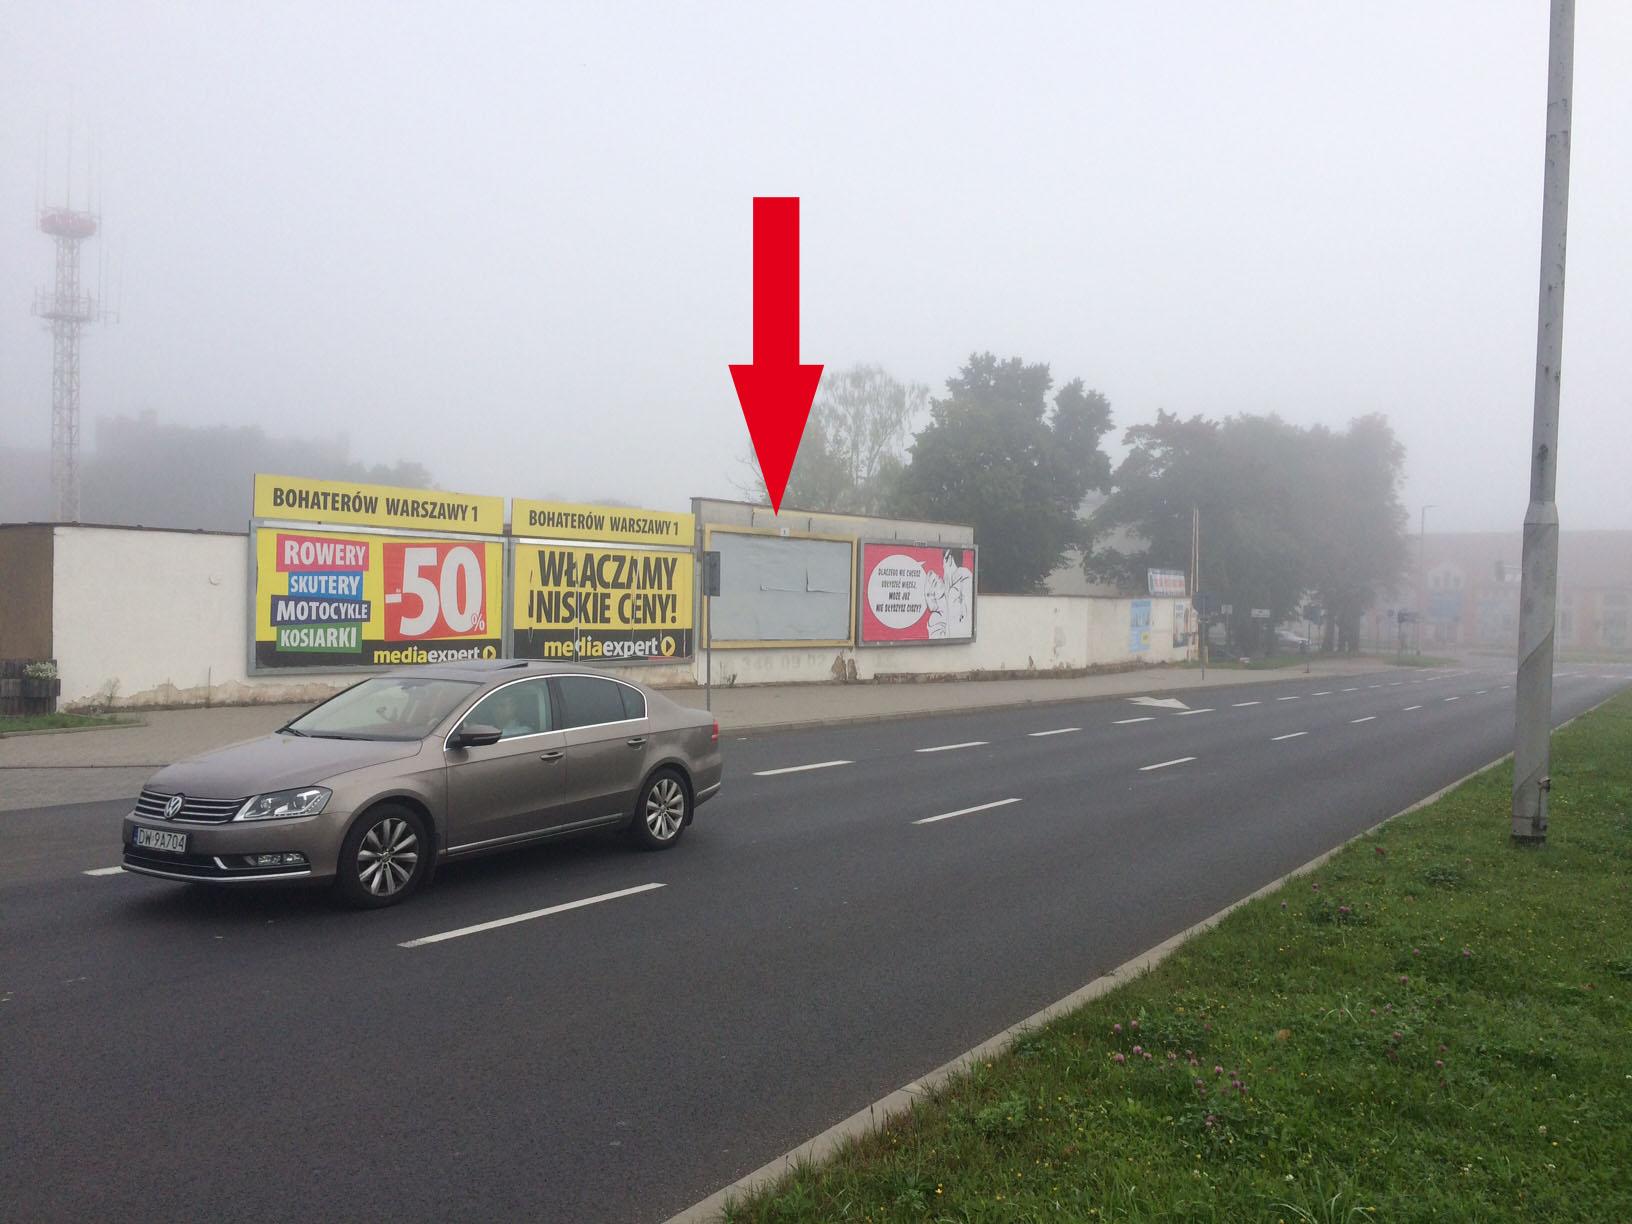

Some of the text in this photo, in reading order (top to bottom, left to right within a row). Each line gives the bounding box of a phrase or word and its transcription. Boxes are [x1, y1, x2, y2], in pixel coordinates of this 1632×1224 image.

[272, 487, 478, 522] BOHATERÓW WARSZAWY 1
[529, 509, 679, 536] BOHATERÓW WARSZAWY 1
[284, 540, 366, 566] ROWERY
[537, 550, 677, 591] WŁĄCZAMY
[290, 575, 360, 595] SKUTERY
[276, 600, 368, 621] MOTOCYKLE
[618, 593, 677, 624] CENY!
[280, 627, 356, 648] KOSIARKI
[138, 829, 185, 851] DW 9A704
